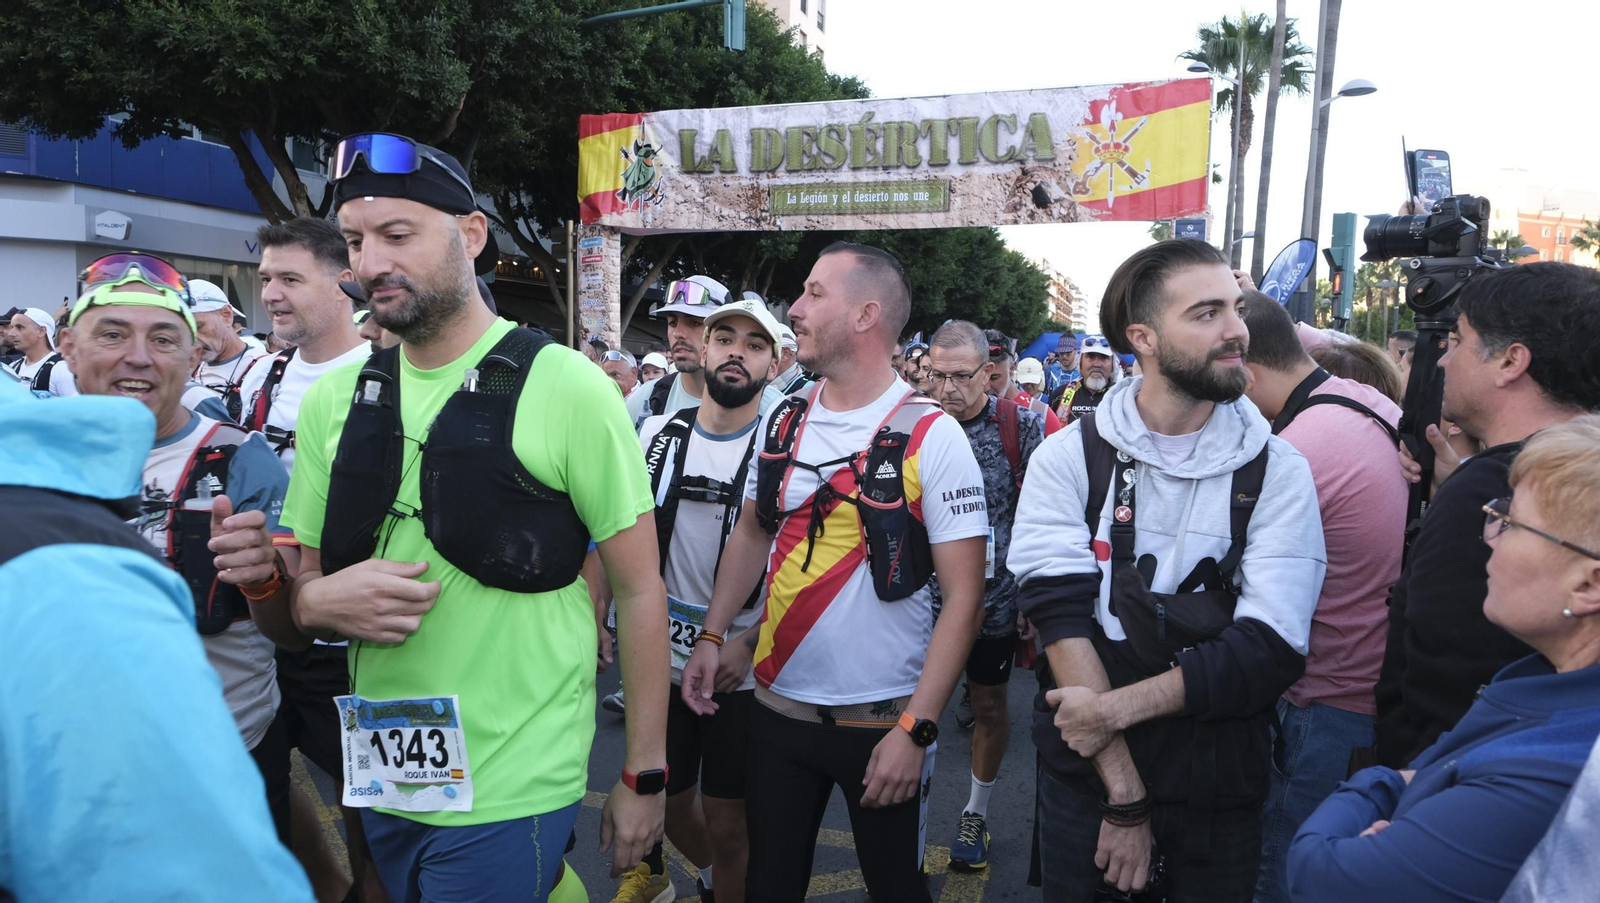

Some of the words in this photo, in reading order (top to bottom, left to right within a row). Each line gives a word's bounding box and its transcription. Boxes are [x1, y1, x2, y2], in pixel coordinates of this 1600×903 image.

[678, 128, 738, 173] LA
[750, 110, 1057, 173] DESÉRTICA
[787, 192, 797, 204] La
[800, 191, 828, 205] Legión
[833, 195, 839, 205] y
[842, 191, 851, 203] el
[854, 190, 889, 202] desierto
[893, 191, 909, 201] nos
[913, 191, 930, 201] une
[942, 491, 954, 502] LA
[951, 505, 961, 515] VI
[370, 728, 449, 769] 1343
[404, 770, 428, 779] ROQUE
[430, 768, 450, 779] IVÁN
